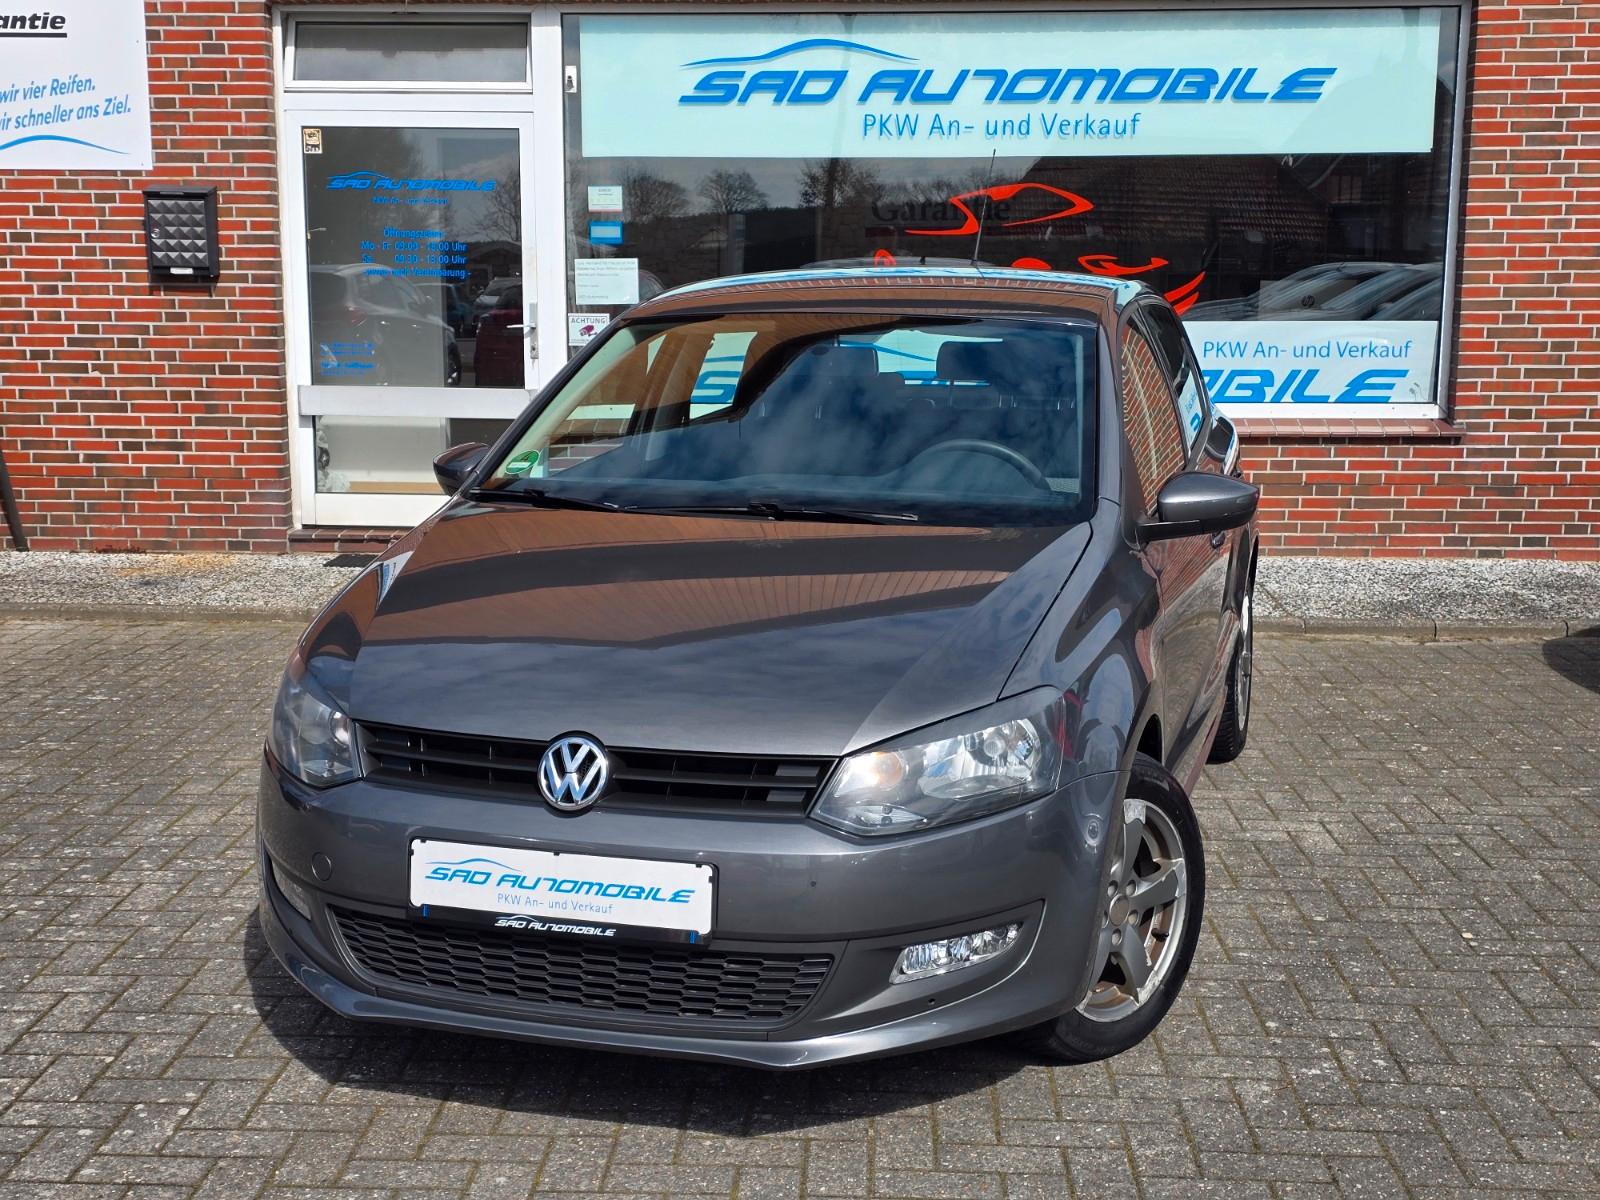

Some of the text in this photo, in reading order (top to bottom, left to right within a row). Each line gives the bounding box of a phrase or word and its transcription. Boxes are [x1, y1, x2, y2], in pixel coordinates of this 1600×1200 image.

[22, 80, 47, 100] vier
[49, 74, 96, 97] Reifen.
[678, 67, 1338, 104] SAD AUTOMOBILE
[0, 94, 131, 131] ir schneller ans Ziel.
[863, 112, 1142, 137] PKW An- und Verkauf
[326, 178, 498, 192] SAD AUTOMOBILE
[451, 241, 467, 252] Uhr
[451, 254, 467, 264] Uhr
[1202, 340, 1413, 358] PKW An- und Verkauf
[424, 866, 696, 903] SAD AUTOMOBILE
[497, 892, 614, 914] PKW An- und Verkauf
[494, 919, 617, 937] SAD AUTOMOBILE
